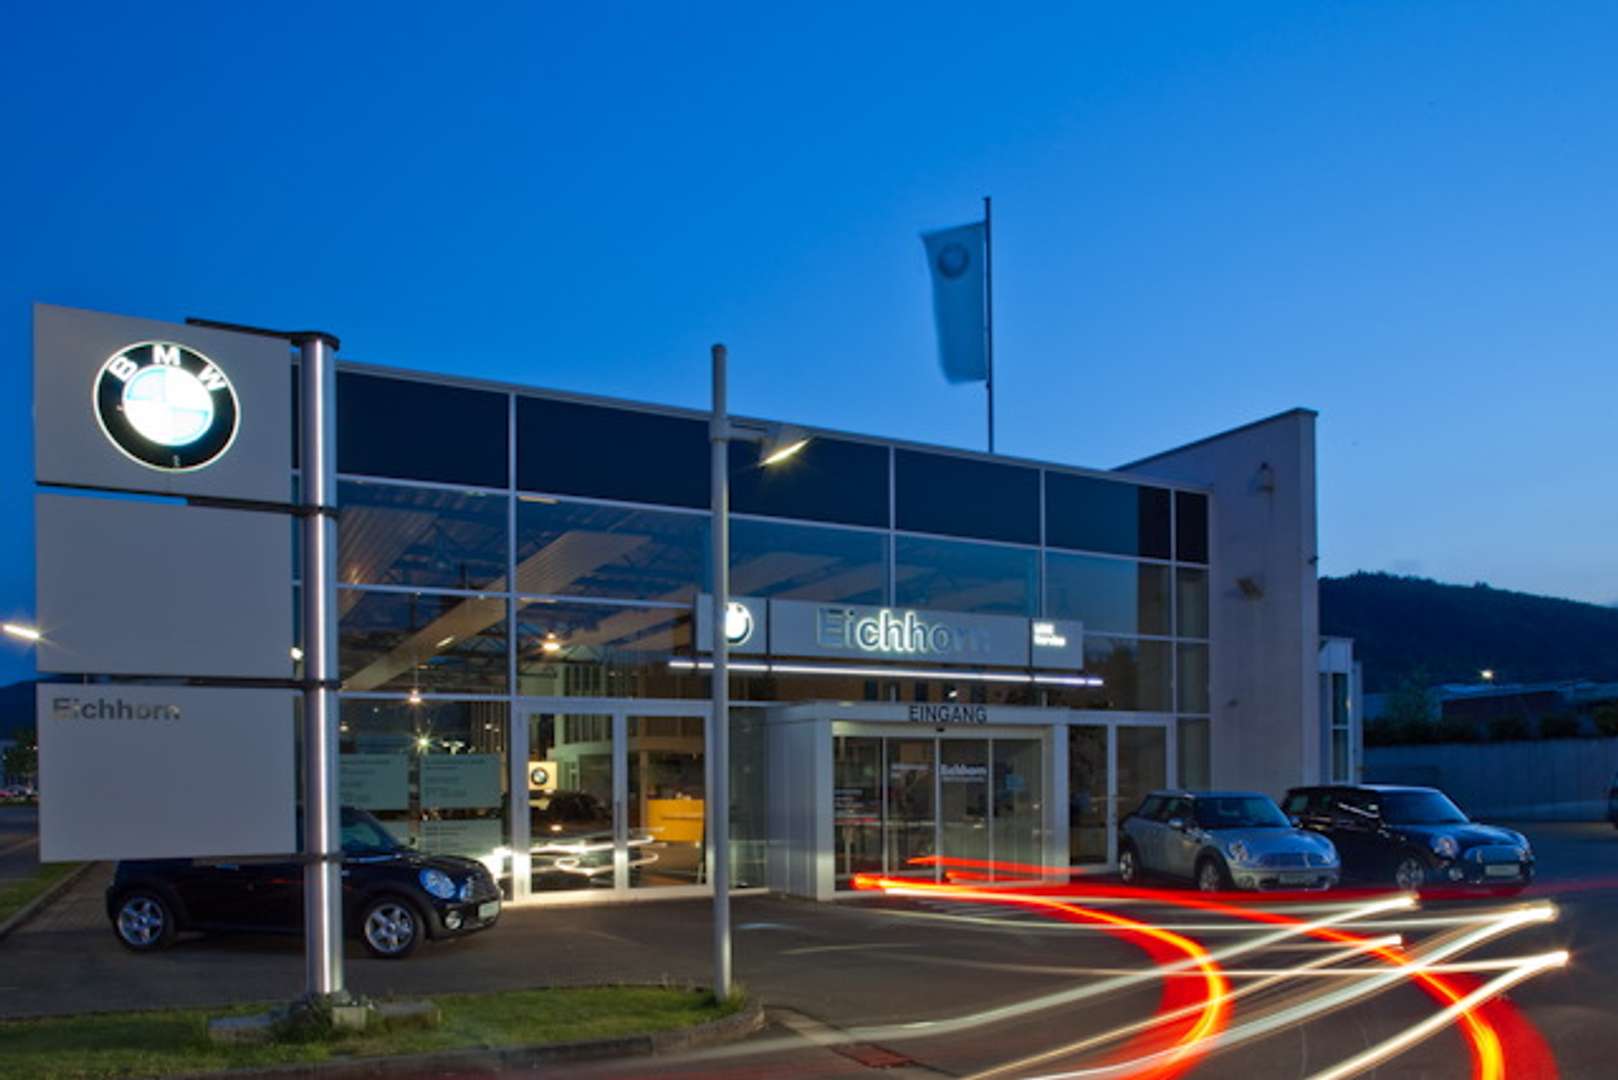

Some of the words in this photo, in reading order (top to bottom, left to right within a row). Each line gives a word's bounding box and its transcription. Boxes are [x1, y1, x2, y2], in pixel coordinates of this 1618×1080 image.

[106, 344, 227, 392] BMW
[52, 698, 180, 720] Eichhorn
[909, 704, 987, 724] EINGANG
